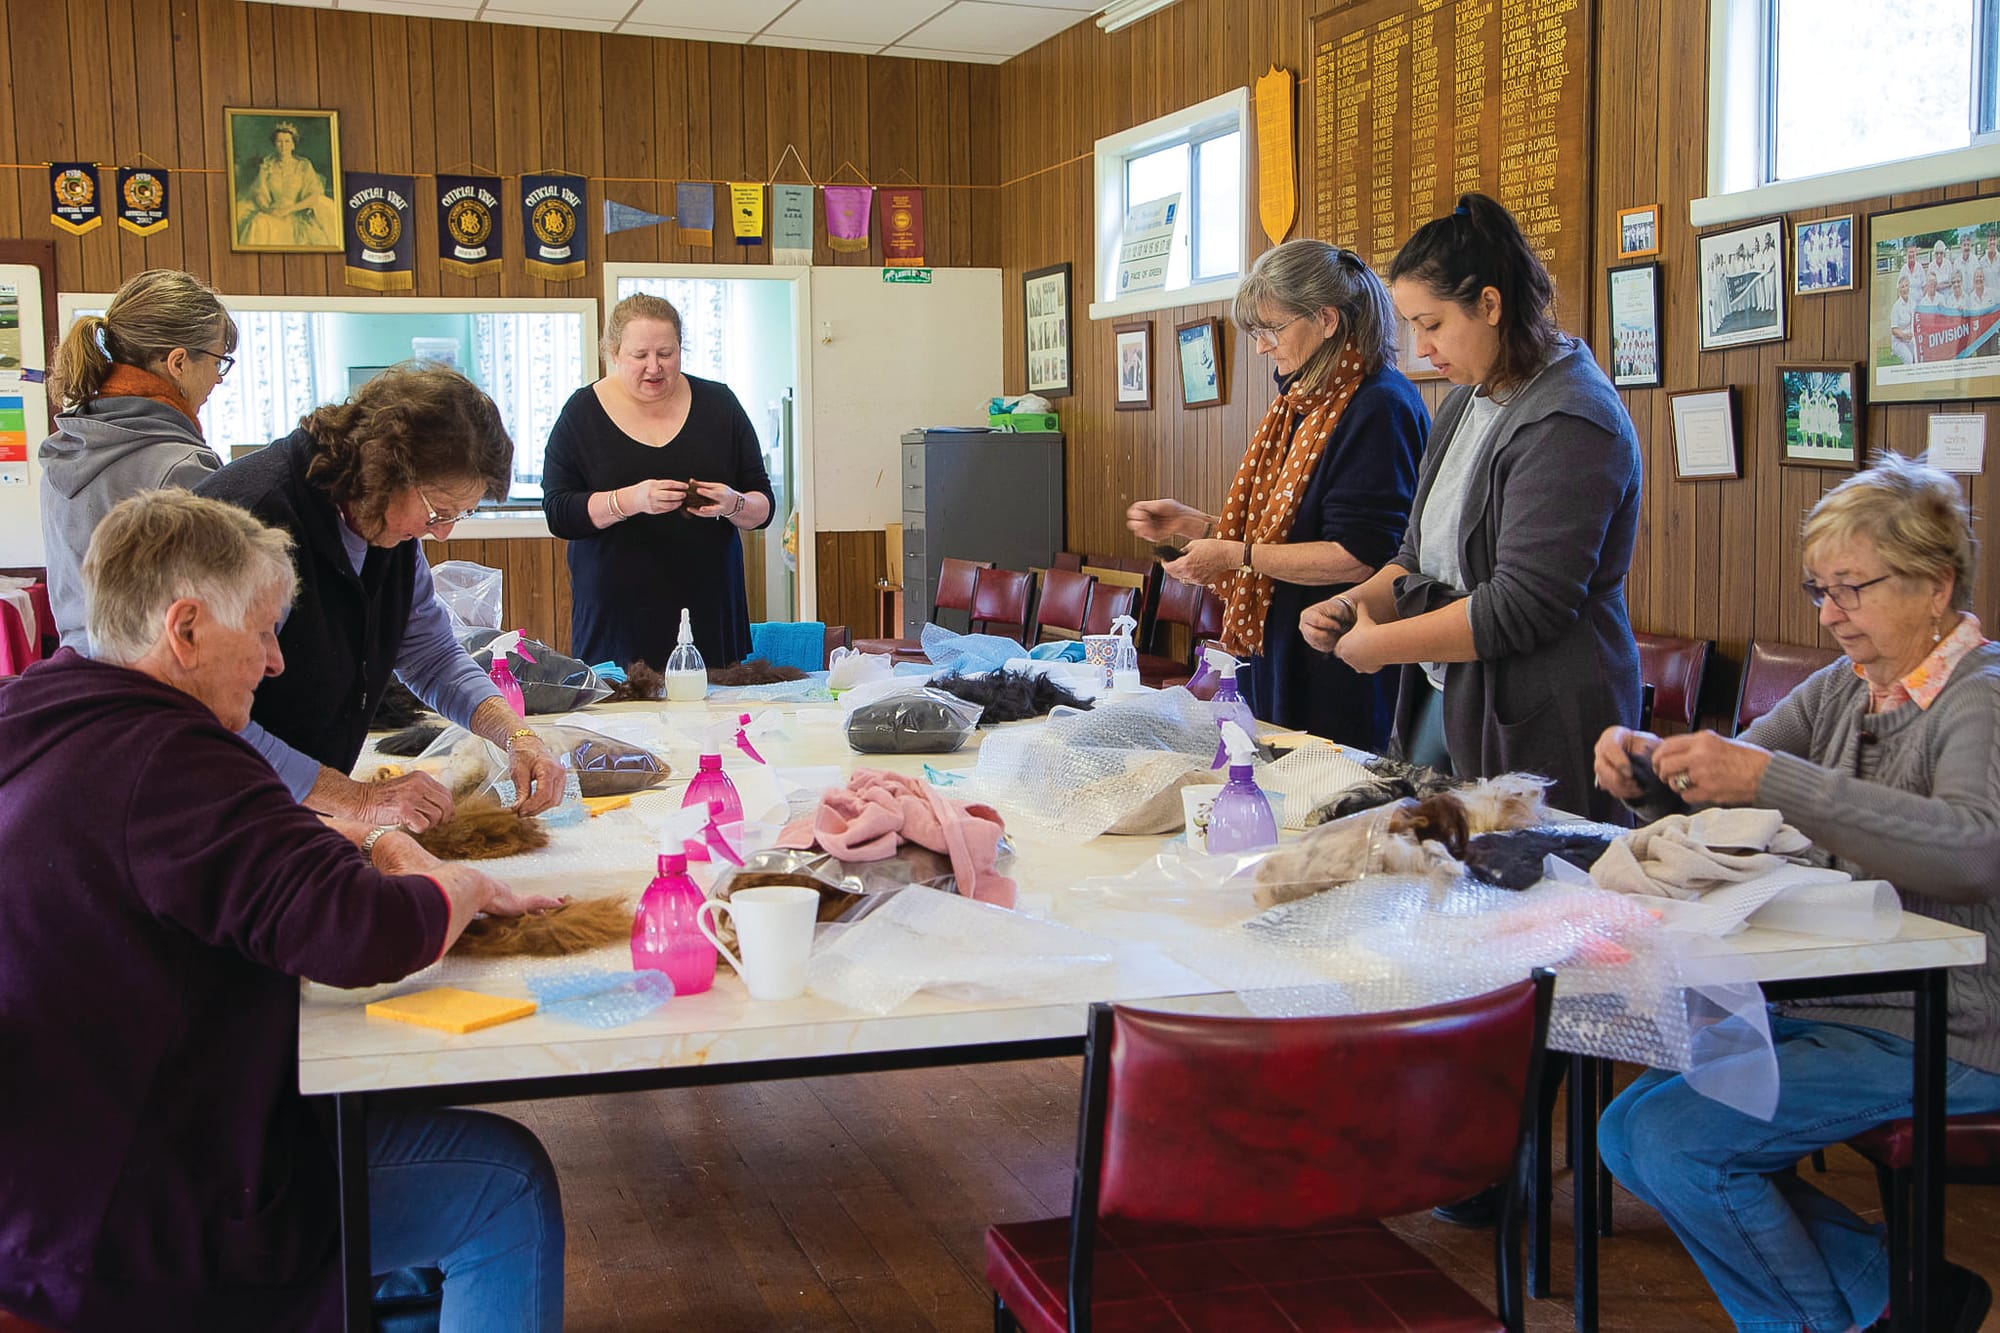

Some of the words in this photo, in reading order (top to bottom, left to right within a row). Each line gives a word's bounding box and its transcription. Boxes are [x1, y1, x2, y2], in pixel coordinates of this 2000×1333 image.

[1423, 0, 1443, 13] TROPHY
[1379, 14, 1404, 30] SECRETARY
[349, 187, 385, 208] OFFICIAL
[387, 190, 408, 210] VISIT
[442, 186, 476, 207] OFFICIAL
[478, 188, 498, 208] VISIT
[525, 186, 560, 207] OFFICIAL
[562, 188, 582, 207] VISIT
[1929, 323, 1969, 348] DIVISION
